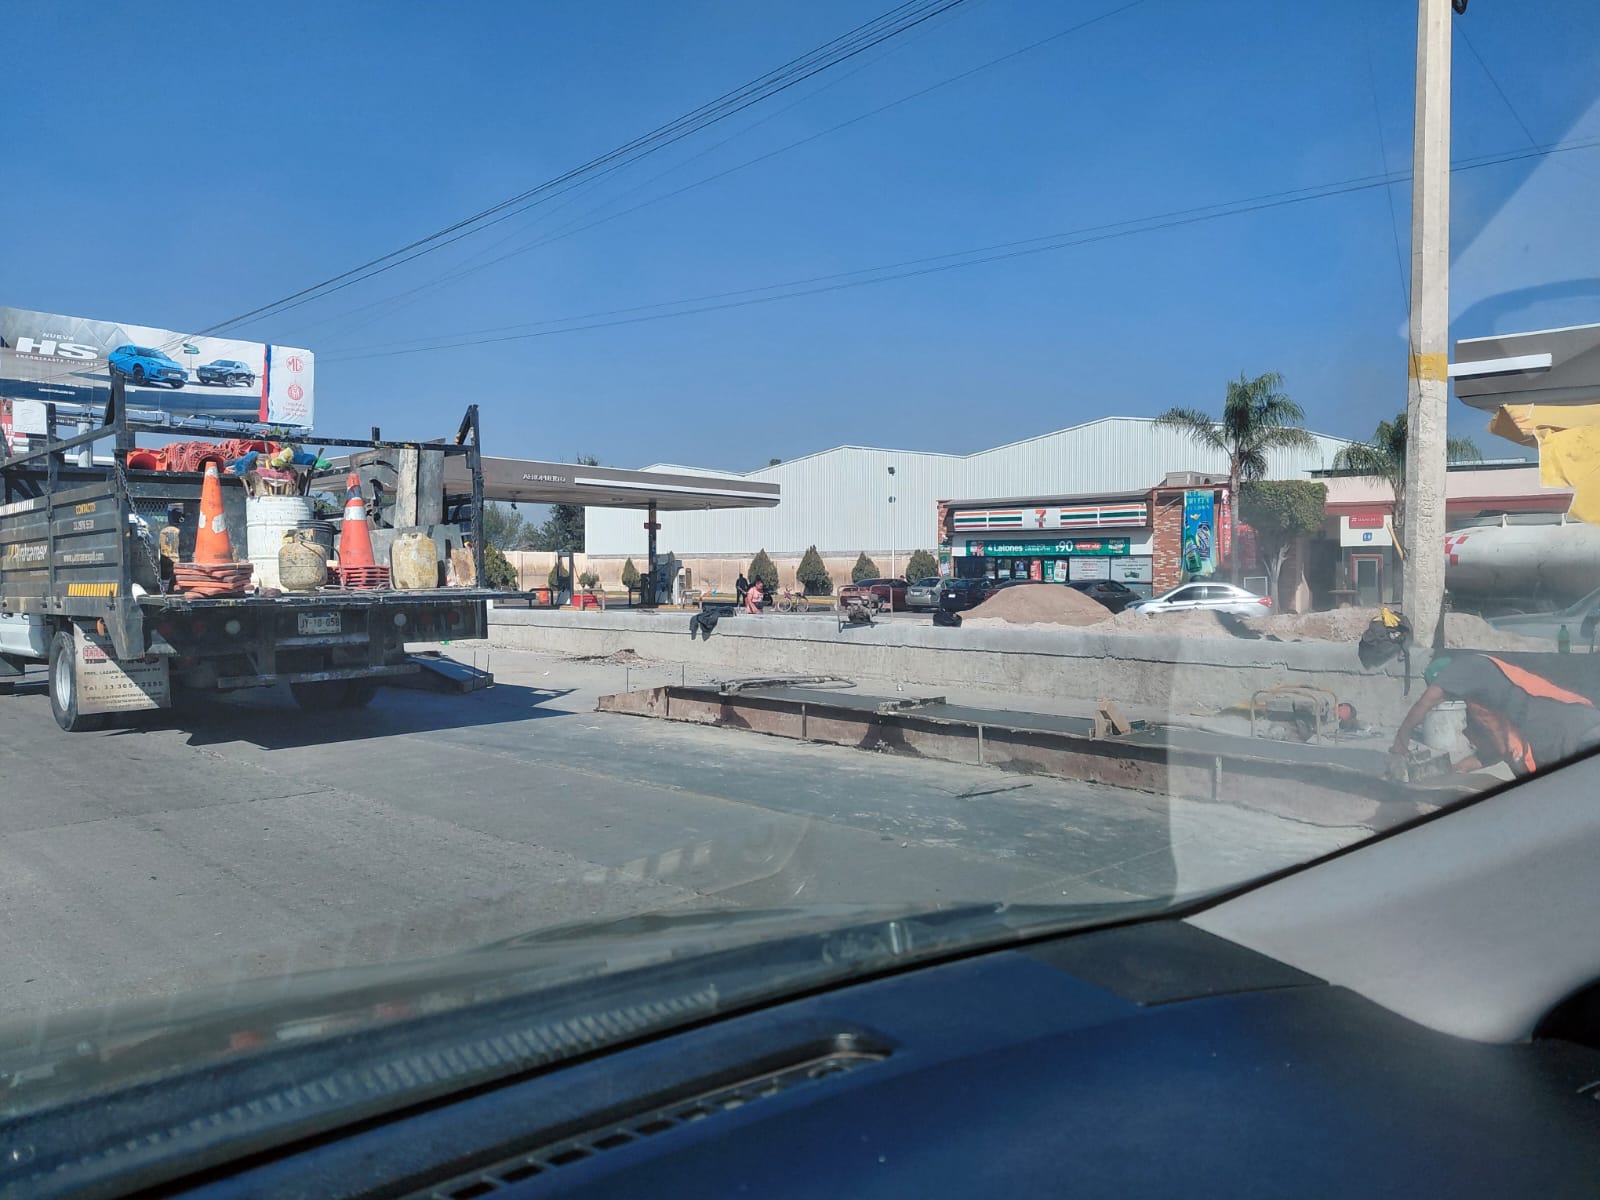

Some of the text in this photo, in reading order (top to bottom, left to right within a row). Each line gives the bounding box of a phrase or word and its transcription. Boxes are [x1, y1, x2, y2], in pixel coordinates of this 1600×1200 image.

[42, 332, 75, 341] NUEVA
[15, 336, 99, 360] HS
[1055, 540, 1073, 553] $90
